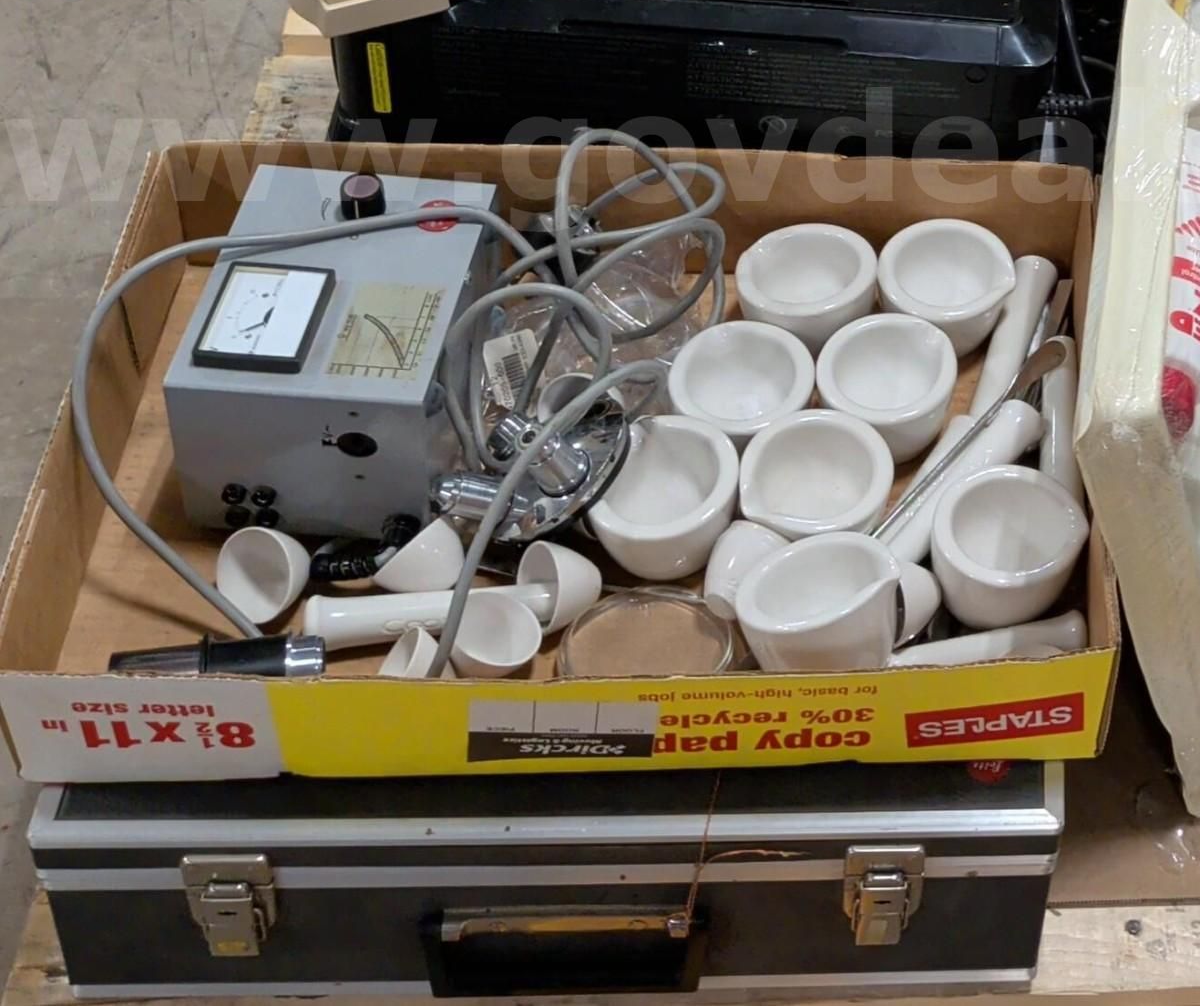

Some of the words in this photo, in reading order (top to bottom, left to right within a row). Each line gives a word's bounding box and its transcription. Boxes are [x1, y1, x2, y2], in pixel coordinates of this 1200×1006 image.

[637, 691, 677, 703] jobs
[680, 688, 793, 701] high-volume
[797, 685, 849, 698] basic,
[853, 685, 878, 696] for
[71, 702, 129, 715] size
[138, 703, 216, 718] letter
[799, 707, 875, 725] 30%
[918, 705, 1073, 738] STAPLES
[753, 728, 872, 751] copy
[518, 743, 611, 755] Dircks
